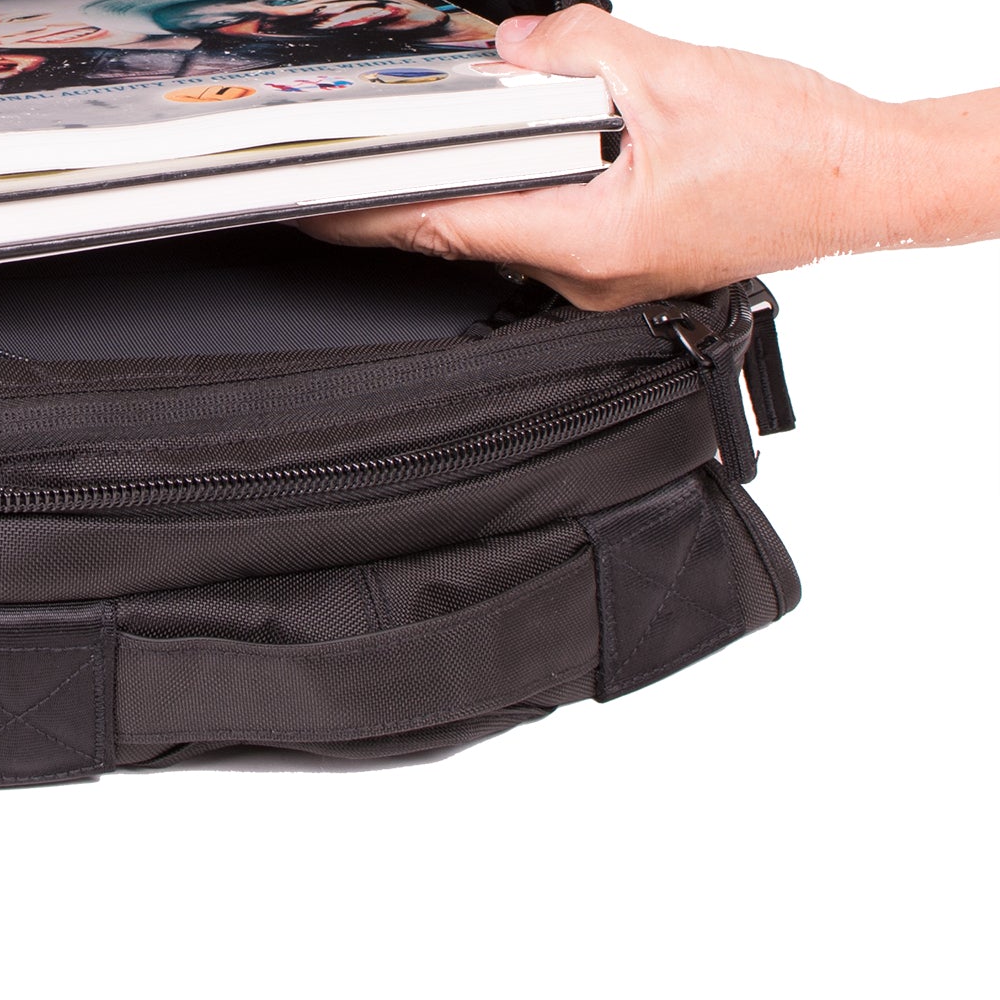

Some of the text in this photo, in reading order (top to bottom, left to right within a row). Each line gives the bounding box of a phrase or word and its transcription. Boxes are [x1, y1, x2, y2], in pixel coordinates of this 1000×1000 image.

[61, 81, 164, 97] ACTIVITY
[171, 77, 204, 85] TO
[210, 69, 276, 81] GROW
[284, 65, 336, 75] THE
[336, 57, 417, 69] WHOLE
